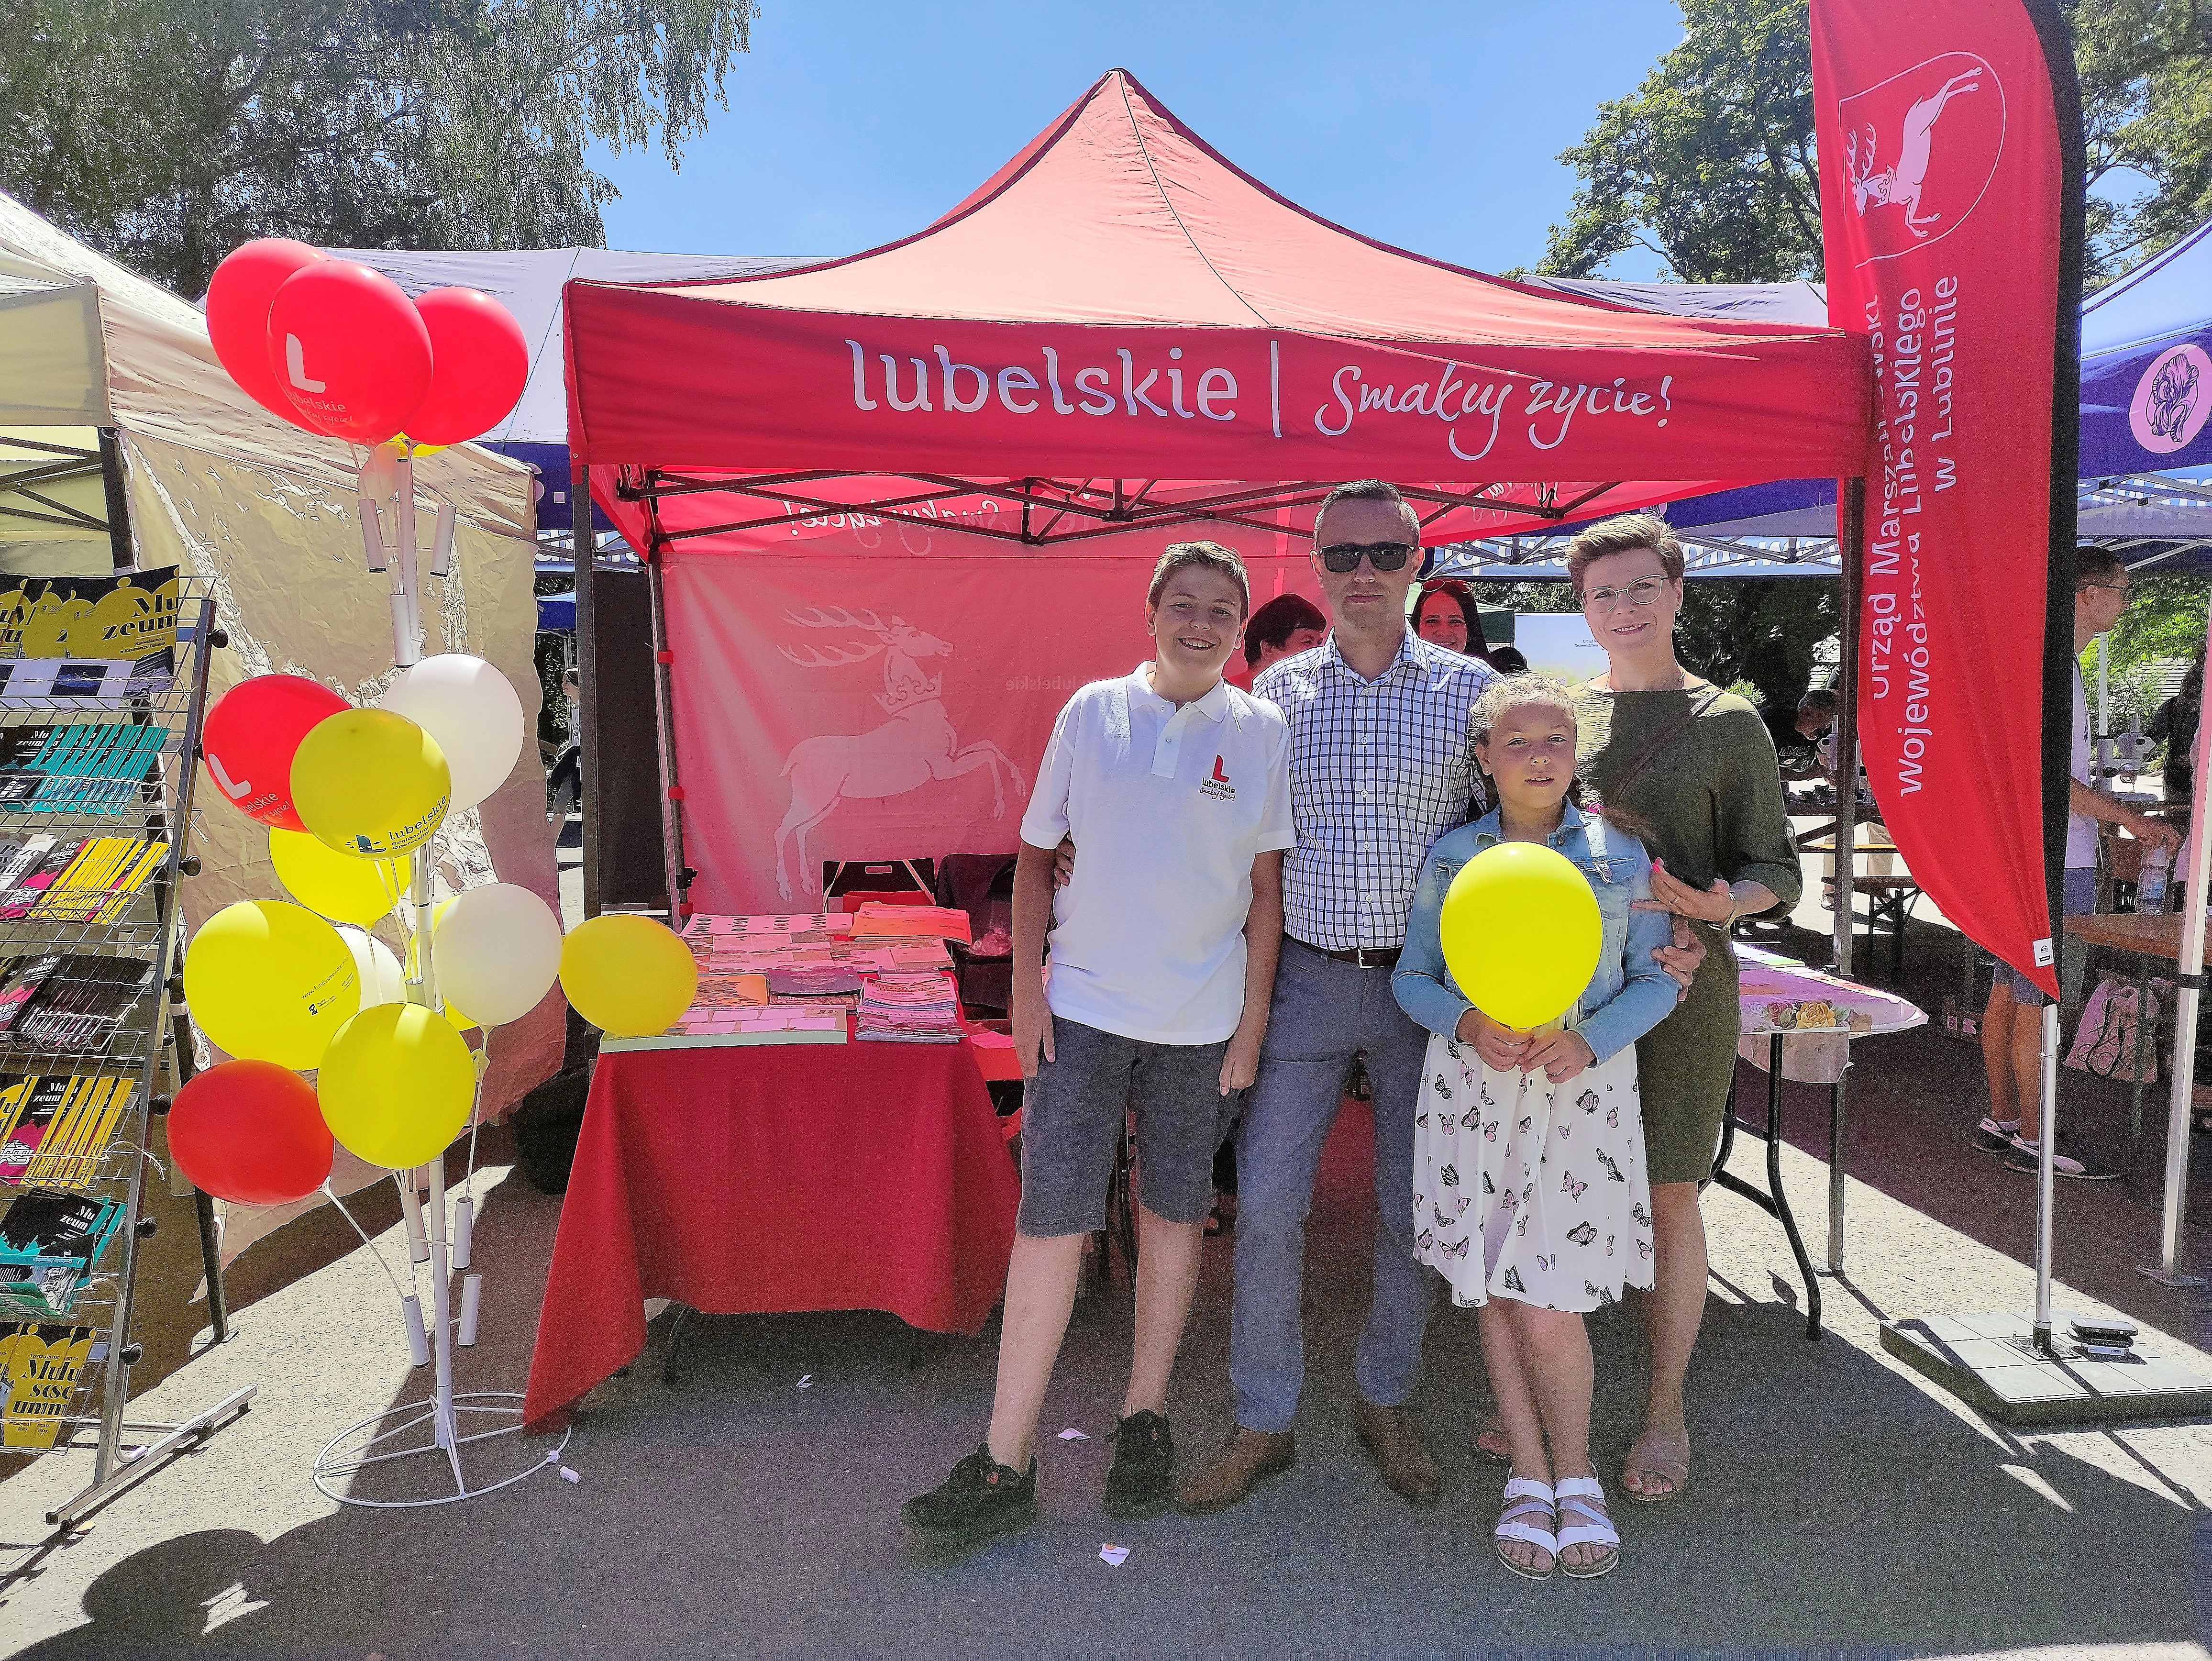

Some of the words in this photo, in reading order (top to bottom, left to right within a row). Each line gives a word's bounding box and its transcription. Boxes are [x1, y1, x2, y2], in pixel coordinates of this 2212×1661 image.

[1929, 275, 1958, 442] Lublinie
[844, 339, 1239, 421] lubelskie
[1314, 362, 1513, 461] Smakuj
[1935, 457, 1957, 492] w
[1868, 592, 1902, 700] Urząd
[1202, 776, 1236, 794] lubelskie
[388, 796, 446, 840] lubelskie
[392, 826, 429, 846] Regionalny
[392, 830, 430, 850] Operacyjny
[59, 1215, 88, 1230] zeum
